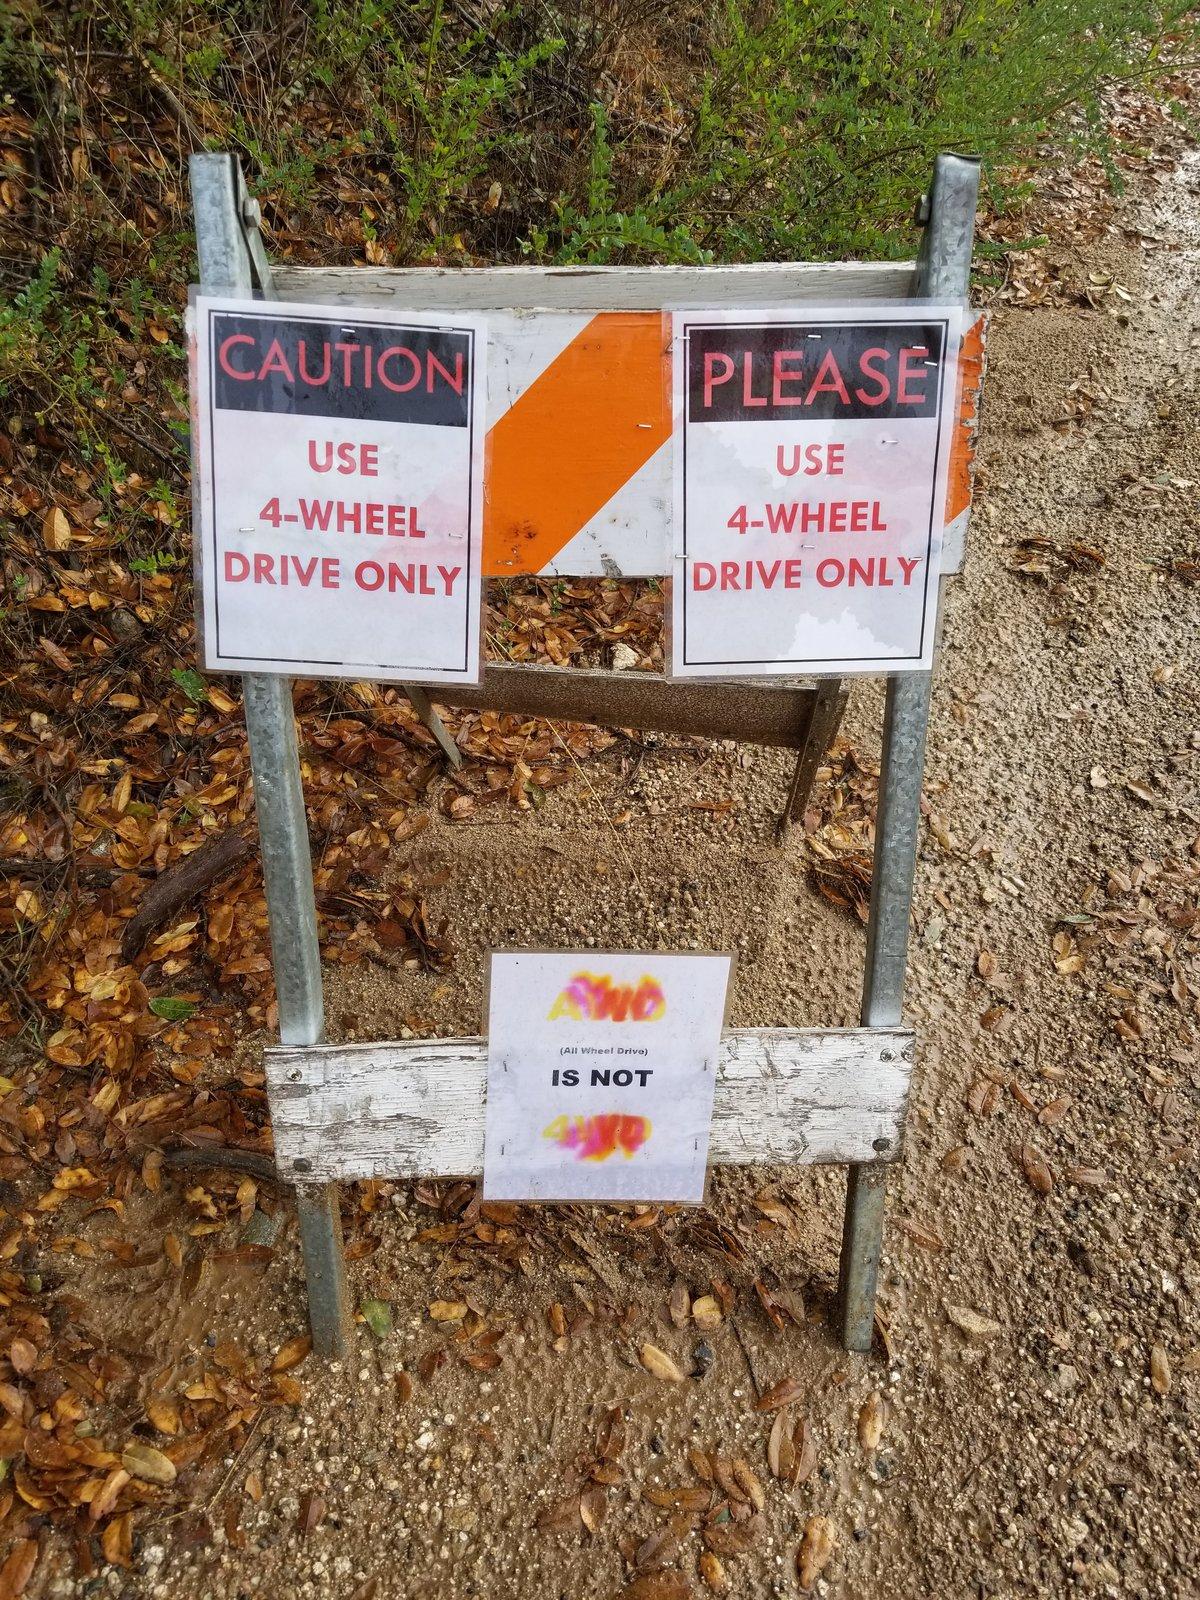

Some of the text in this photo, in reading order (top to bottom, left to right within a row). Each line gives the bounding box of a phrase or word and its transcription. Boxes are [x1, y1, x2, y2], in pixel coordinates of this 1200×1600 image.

[218, 334, 463, 396] CAUTION
[703, 348, 930, 408] PLEASE
[308, 440, 379, 477] USE
[776, 443, 845, 477] USE
[259, 498, 426, 539] 4-WHEEL
[726, 501, 888, 535] 4-WHEEL
[224, 551, 462, 597] DRIVE ONLY
[692, 556, 919, 592] DRIVE ONLY
[560, 1046, 648, 1056] (All Wheel Drive)
[552, 1069, 654, 1087] IS NOT
